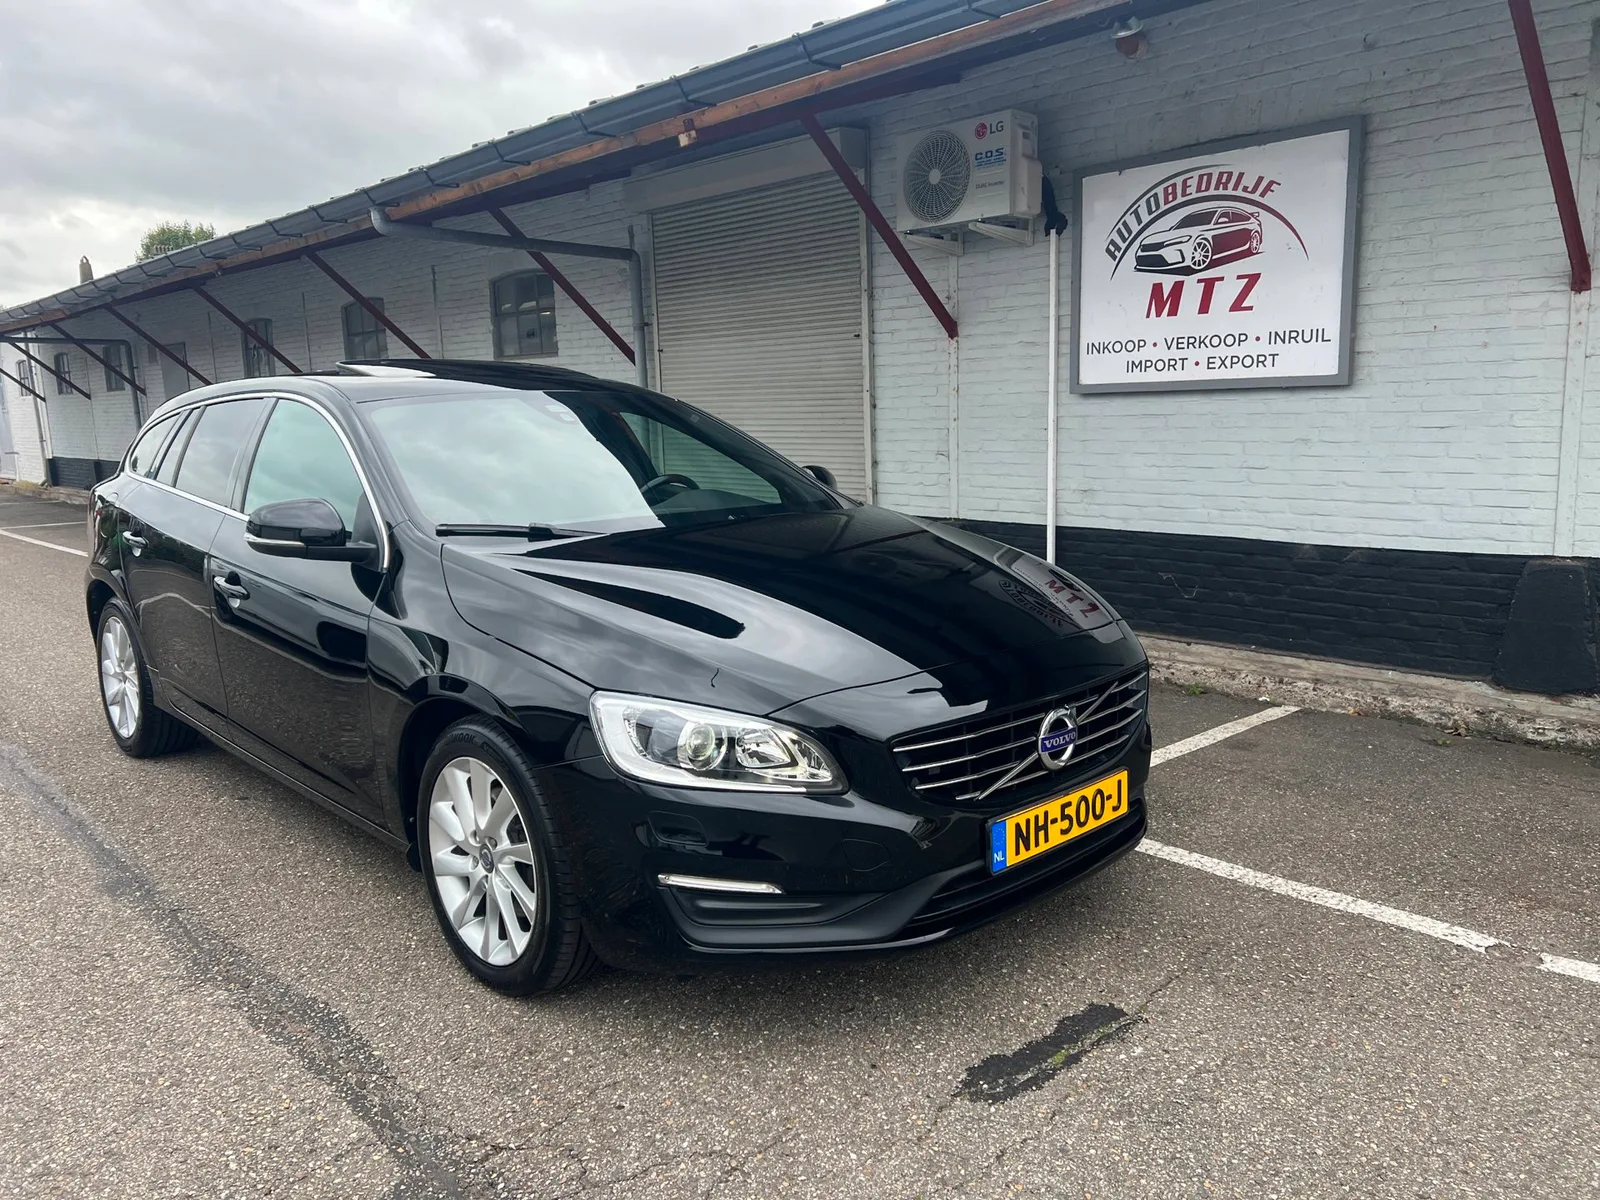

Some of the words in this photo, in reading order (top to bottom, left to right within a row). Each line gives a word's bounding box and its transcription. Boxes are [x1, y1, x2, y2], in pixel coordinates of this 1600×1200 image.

[990, 121, 1004, 134] LG
[1105, 171, 1282, 262] AUTOBEDRIJF
[1145, 272, 1262, 319] MTZ
[1086, 339, 1147, 355] INKOOP
[1163, 332, 1249, 351] VERKOOP
[1268, 328, 1332, 346] INRUIL
[1126, 358, 1188, 374] IMPORT
[1206, 353, 1280, 371] EXPORT
[1044, 731, 1076, 748] VOLVO
[1014, 779, 1122, 857] NH-500-J
[993, 852, 1005, 864] NL
